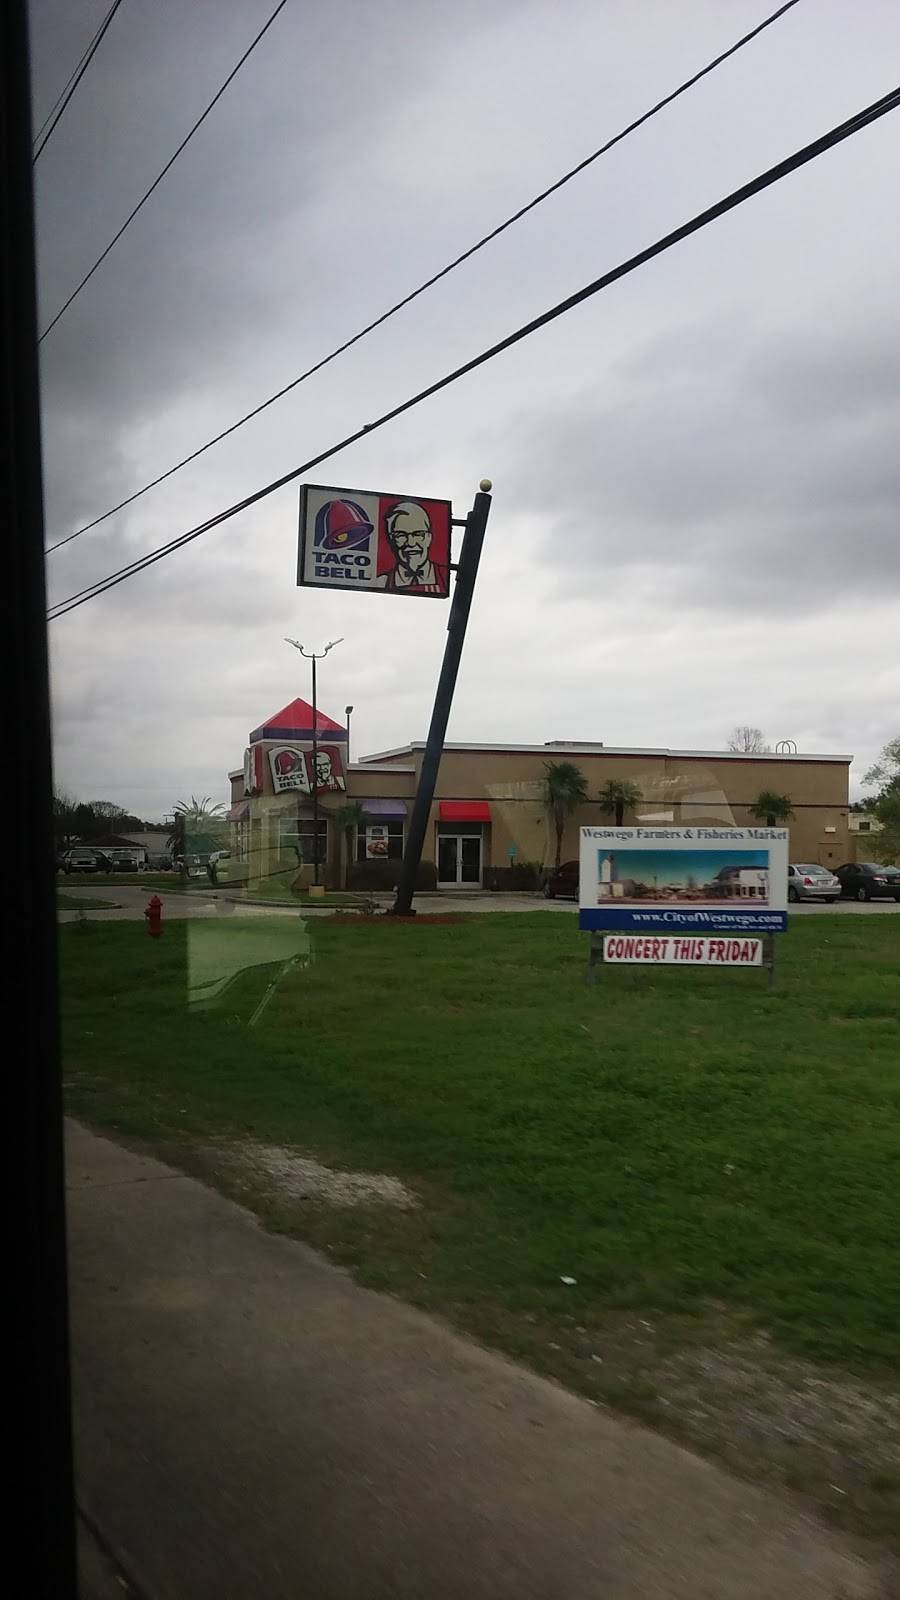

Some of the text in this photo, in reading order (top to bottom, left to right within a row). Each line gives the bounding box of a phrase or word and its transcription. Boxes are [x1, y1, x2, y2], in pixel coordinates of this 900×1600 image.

[312, 552, 371, 566] TACO
[315, 566, 371, 580] BELL
[277, 773, 304, 782] TACO
[279, 780, 306, 788] BELL
[582, 828, 787, 841] Westwego Farmers & Fisheries Market
[632, 911, 783, 925] www.CityofWestwego.com
[607, 938, 759, 962] CONCERT THIS FRIDAY
